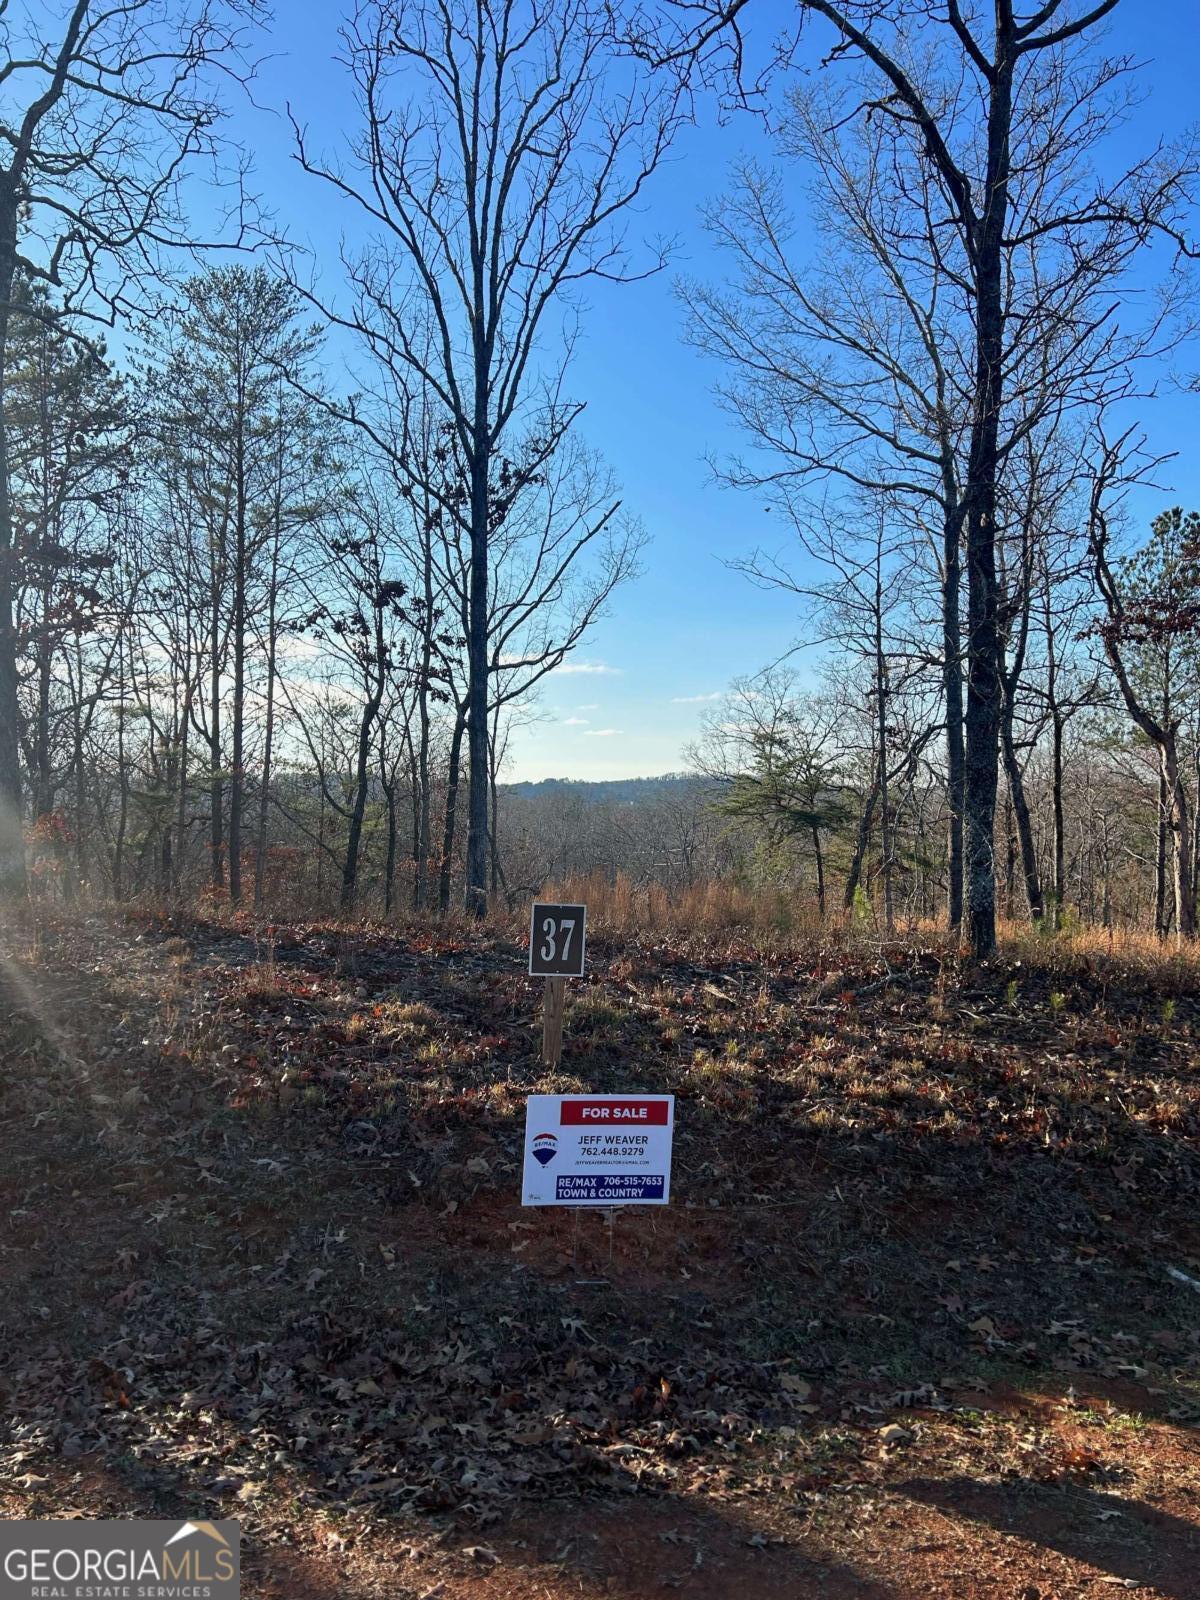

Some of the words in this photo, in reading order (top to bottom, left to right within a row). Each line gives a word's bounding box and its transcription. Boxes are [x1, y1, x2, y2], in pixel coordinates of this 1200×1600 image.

[541, 917, 576, 962] 37
[582, 1108, 610, 1119] FOR
[613, 1108, 648, 1119] SALE
[534, 1140, 556, 1148] RE/MAX
[578, 1135, 603, 1145] JEFF
[604, 1135, 649, 1145] WEAVER
[581, 1147, 644, 1156] 762.448.9279
[558, 1177, 597, 1188] RE/MAX
[603, 1176, 662, 1186] 706-515-7653
[557, 1188, 588, 1198] TOWN
[589, 1188, 596, 1198] &
[598, 1188, 644, 1198] COUNTRY
